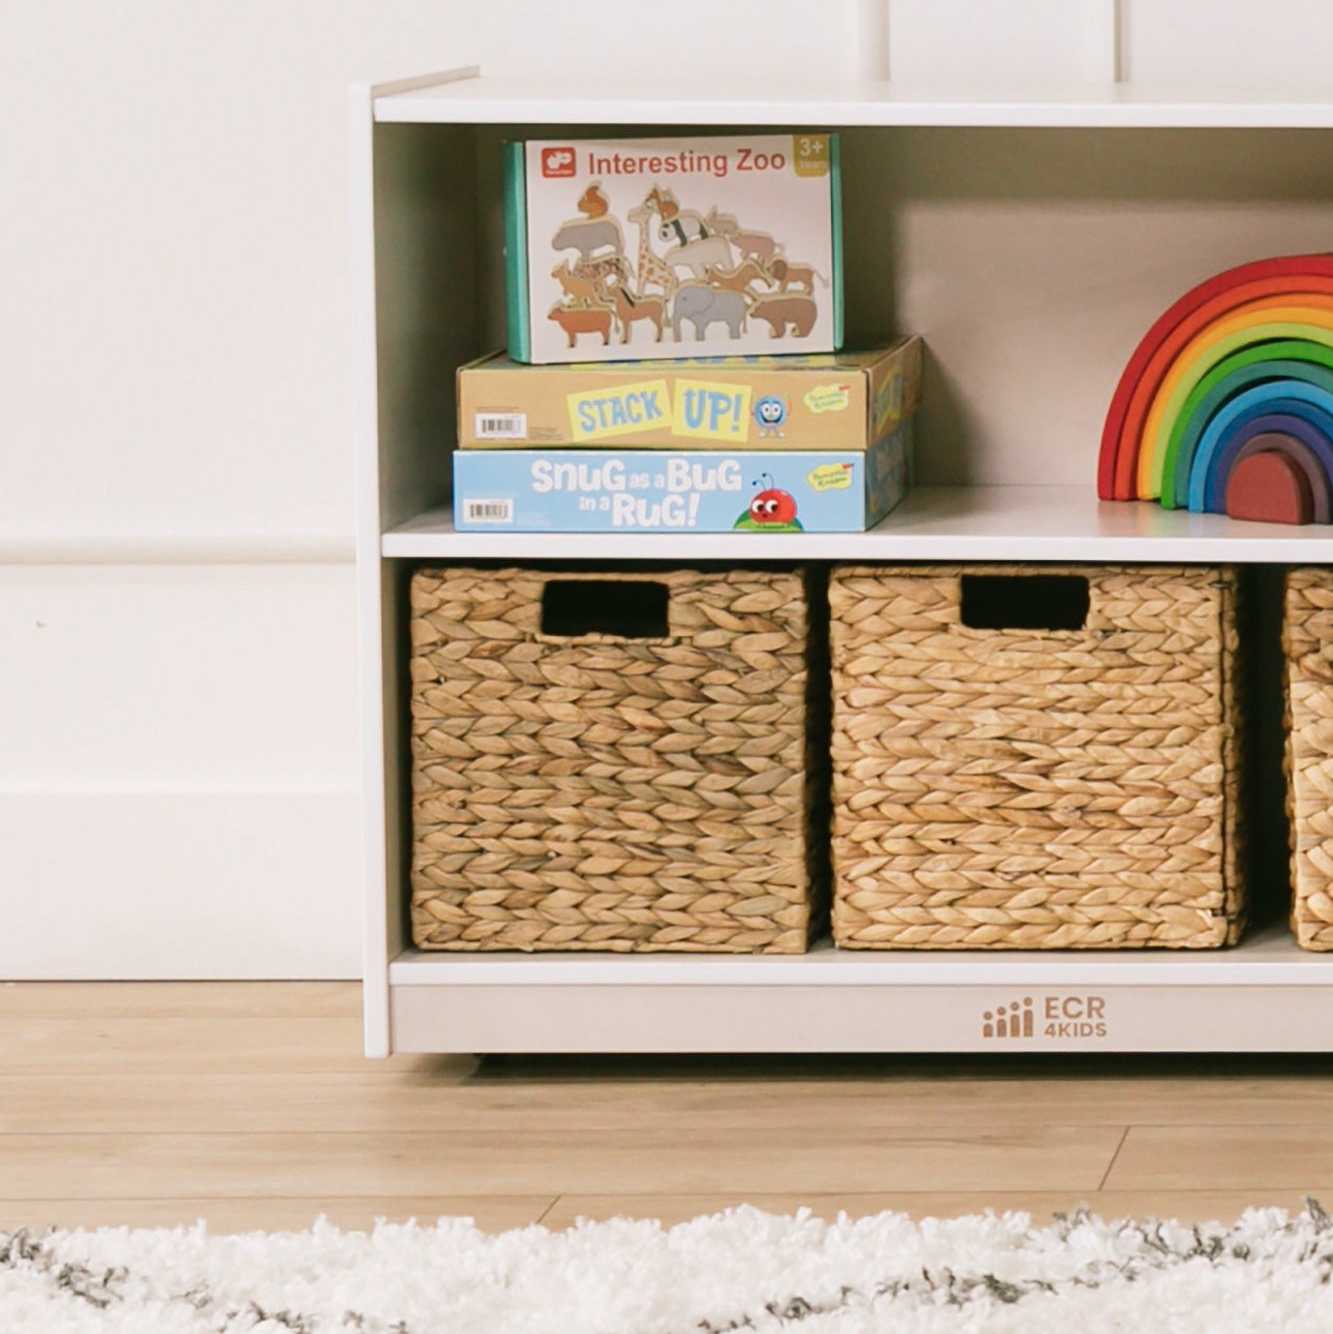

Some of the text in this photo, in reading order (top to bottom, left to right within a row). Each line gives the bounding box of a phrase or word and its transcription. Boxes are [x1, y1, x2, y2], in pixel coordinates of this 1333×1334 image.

[800, 138, 823, 156] 3+
[589, 149, 786, 176] Interesting Zoo
[577, 389, 743, 433] STACK UP!
[630, 473, 650, 487] as
[654, 476, 665, 488] a
[579, 496, 595, 511] in
[599, 499, 610, 511] a
[1044, 996, 1105, 1019] ECR
[1044, 1022, 1107, 1037] 4KIDS
